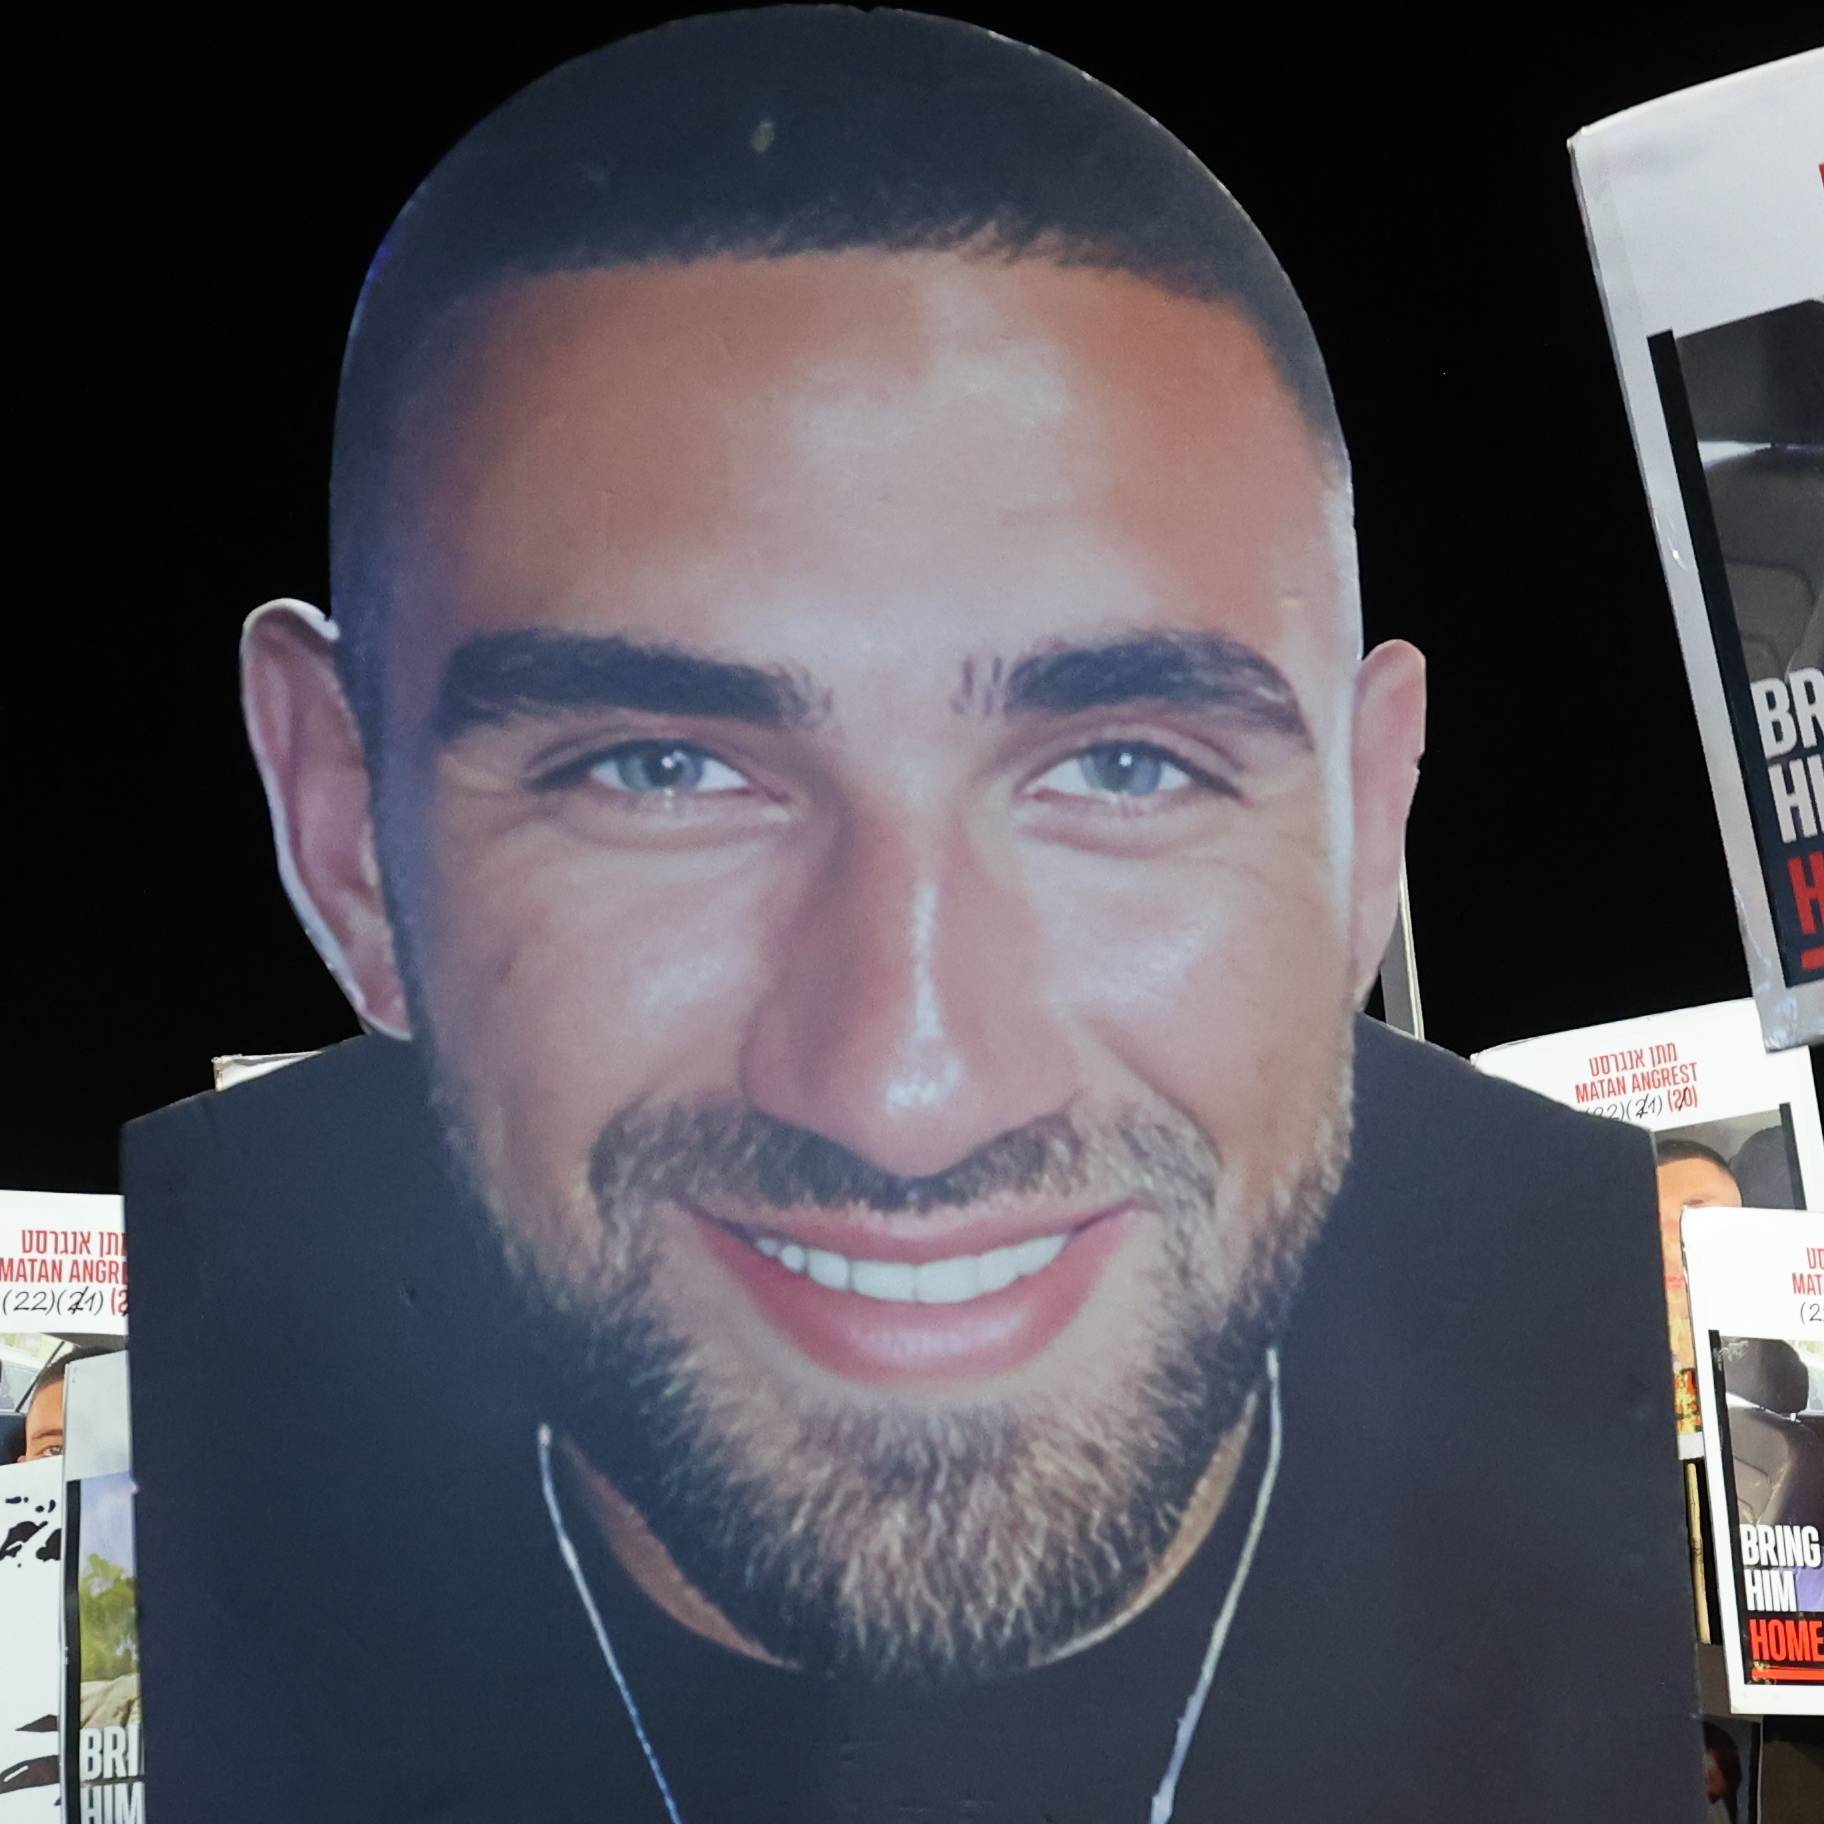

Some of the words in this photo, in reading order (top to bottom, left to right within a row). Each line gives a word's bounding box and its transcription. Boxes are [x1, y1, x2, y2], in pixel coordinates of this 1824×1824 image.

[1649, 1043, 1677, 1067] מתן
[1575, 1077, 1626, 1103] MATAN
[1632, 1062, 1697, 1093] ANGREST
[1740, 1525, 1821, 1568] BRING
[1744, 1569, 1797, 1613] HIM
